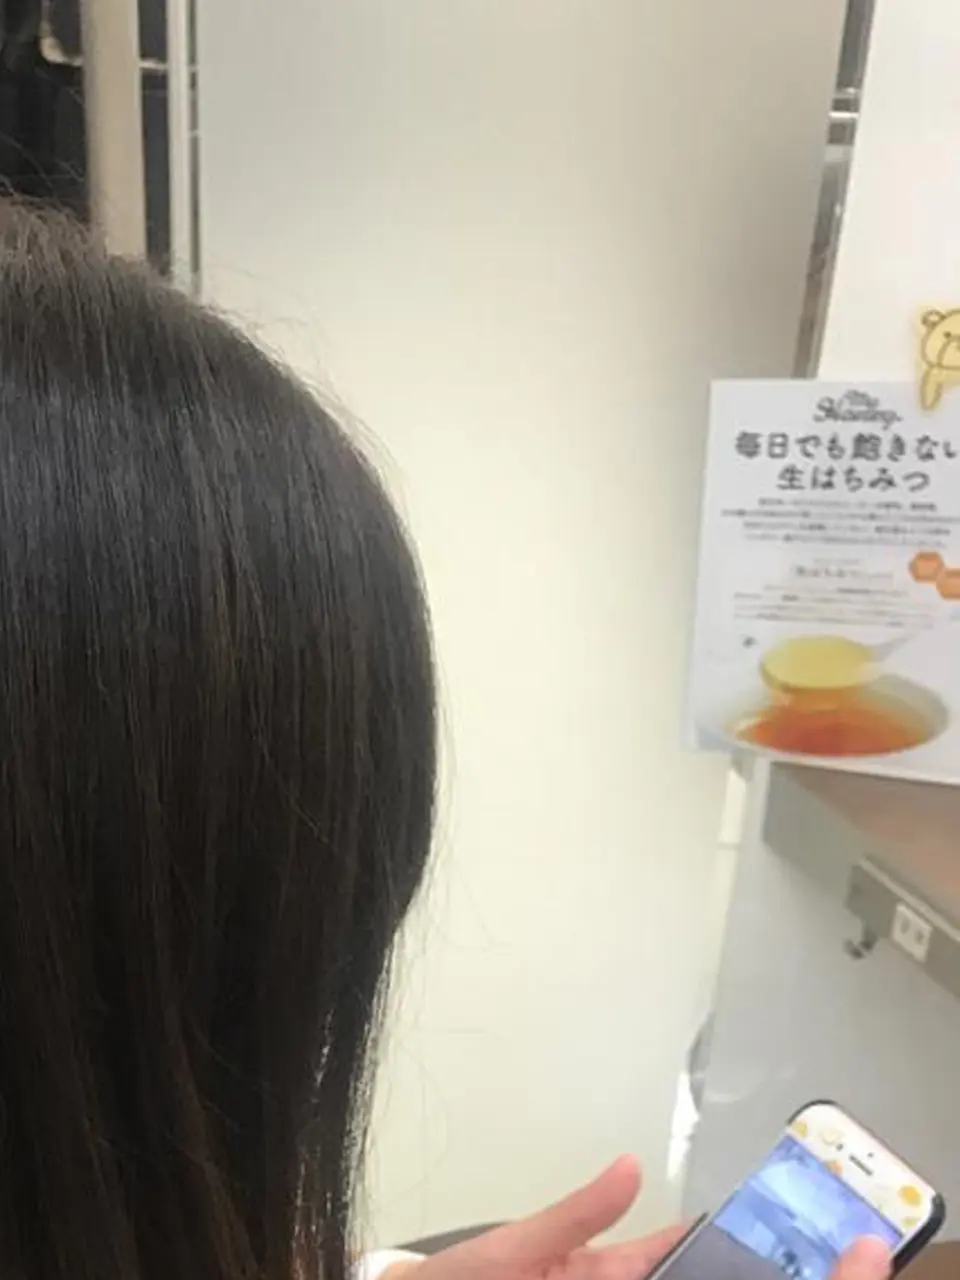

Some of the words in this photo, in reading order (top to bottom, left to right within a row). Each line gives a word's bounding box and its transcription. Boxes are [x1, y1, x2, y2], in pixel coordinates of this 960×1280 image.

[776, 463, 930, 493] 生はちみつ
